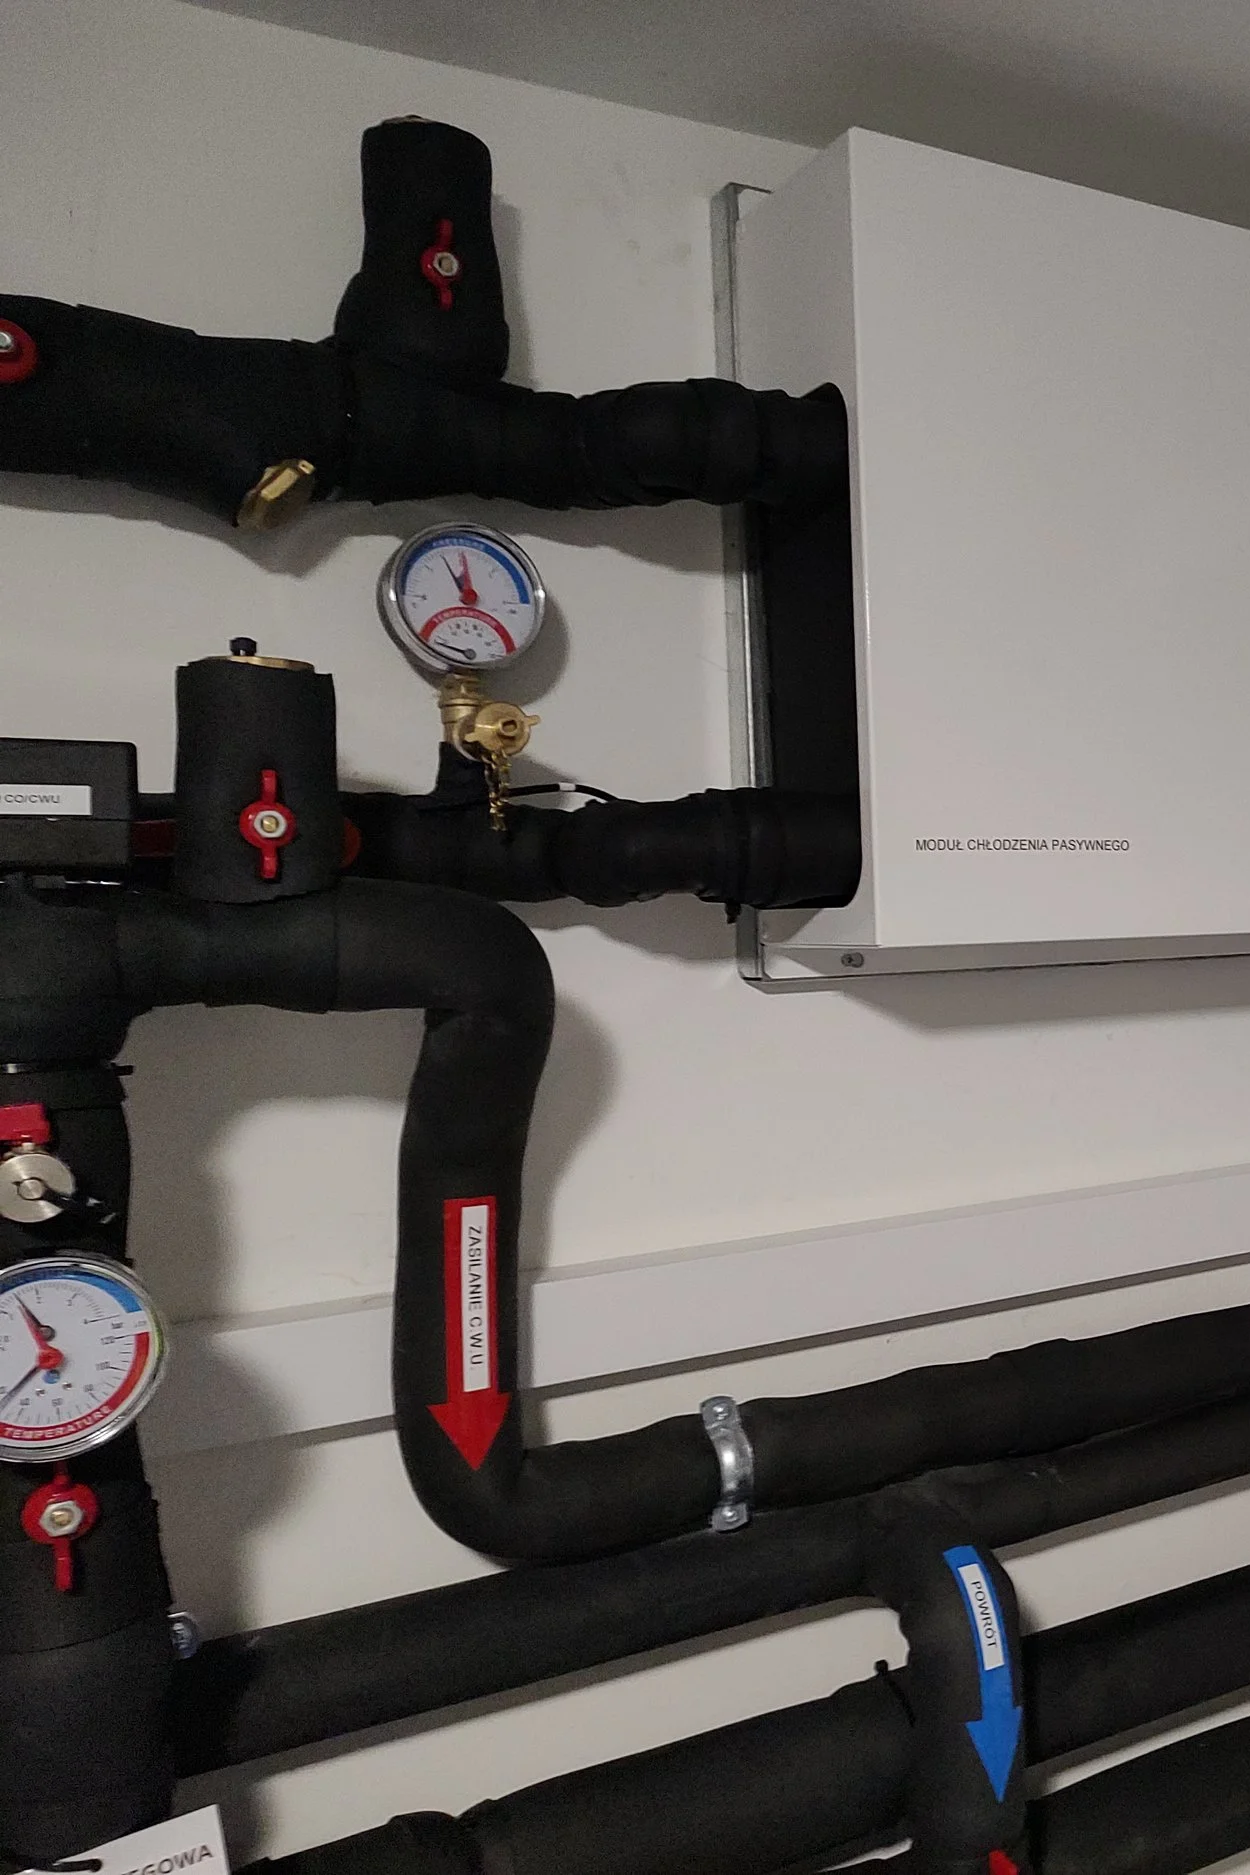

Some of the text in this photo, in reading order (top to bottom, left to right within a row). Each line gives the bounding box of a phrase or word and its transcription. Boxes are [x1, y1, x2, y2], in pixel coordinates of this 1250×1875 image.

[915, 839, 1130, 851] MODUŁ CHŁODZENIA PASYWNEGO
[468, 1225, 483, 1311] ZASILANIE
[3, 1405, 112, 1440] TEMPERATURE
[971, 1580, 998, 1648] POWRÓT
[121, 1844, 213, 1875] GOWA
